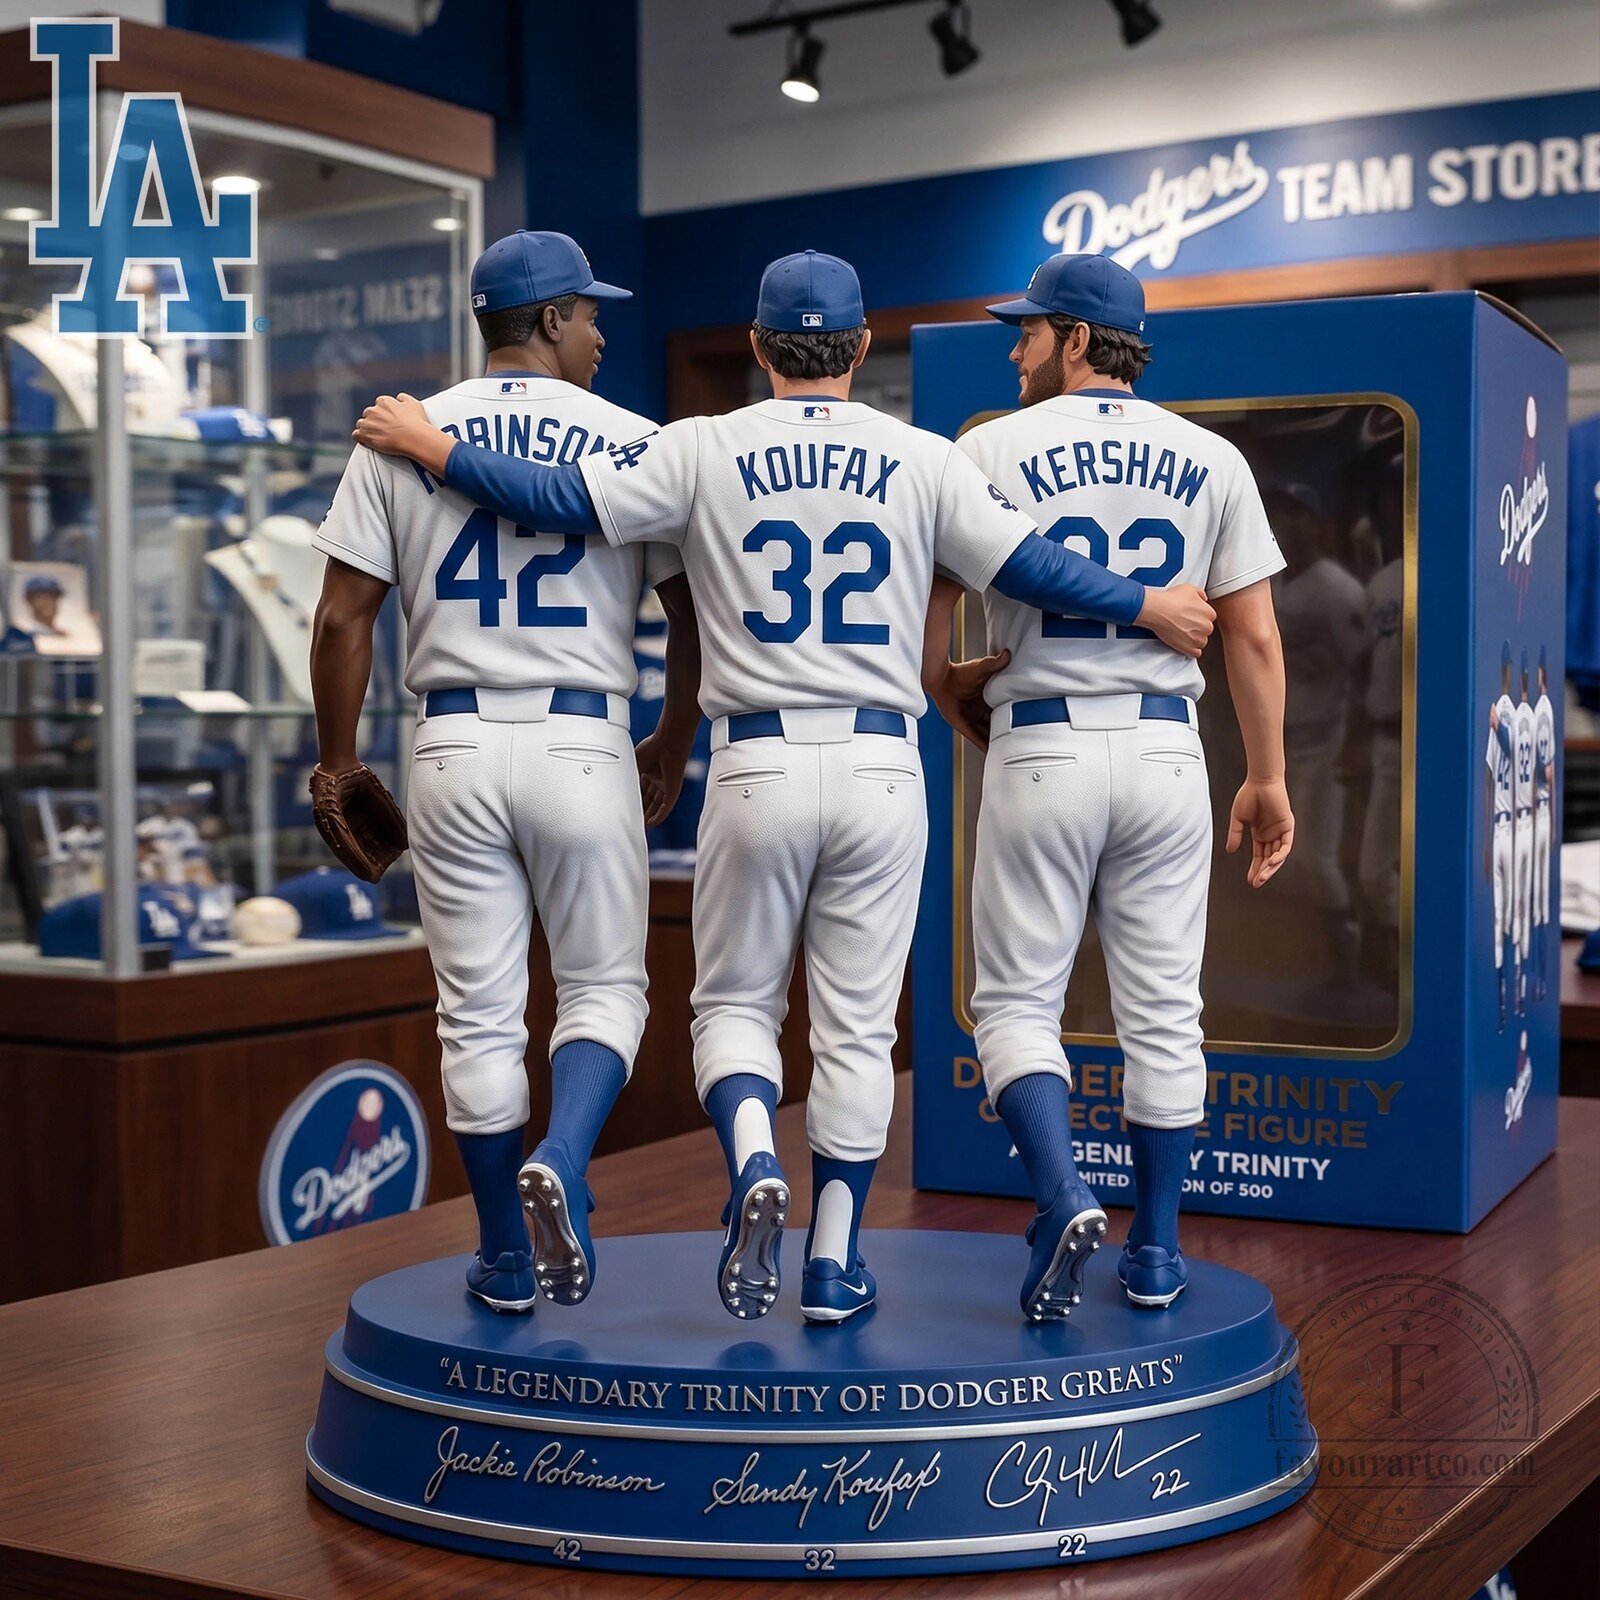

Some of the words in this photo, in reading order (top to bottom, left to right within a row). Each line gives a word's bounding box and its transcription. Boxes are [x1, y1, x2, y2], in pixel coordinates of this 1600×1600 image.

[1042, 140, 1269, 270] Dodgers
[1276, 153, 1414, 223] TEAM
[1428, 132, 1600, 207] STORE
[736, 443, 901, 505] KOUFAX
[1019, 440, 1209, 508] KERSHAW
[435, 508, 588, 627] 42
[742, 519, 891, 645] 32
[1206, 1071, 1405, 1115] TRINITY
[1224, 1113, 1368, 1149] FIGURE
[292, 1125, 411, 1231] Dodgers
[1209, 1180, 1234, 1196] OF
[1239, 1184, 1273, 1199] 500
[1213, 1151, 1331, 1181] TRINITY
[474, 1364, 672, 1409] LEGENDARY
[679, 1383, 830, 1413] TRINITY
[839, 1385, 886, 1412] OF
[899, 1375, 1053, 1412] DODGER
[423, 1426, 518, 1503] Jackie
[523, 1441, 665, 1493] Robinson
[1151, 1469, 1191, 1500] 22
[704, 1451, 818, 1529] Sandy
[821, 1449, 941, 1531] Koufax
[552, 1539, 582, 1562] 42
[805, 1549, 836, 1571] 32
[1058, 1534, 1087, 1558] 22
